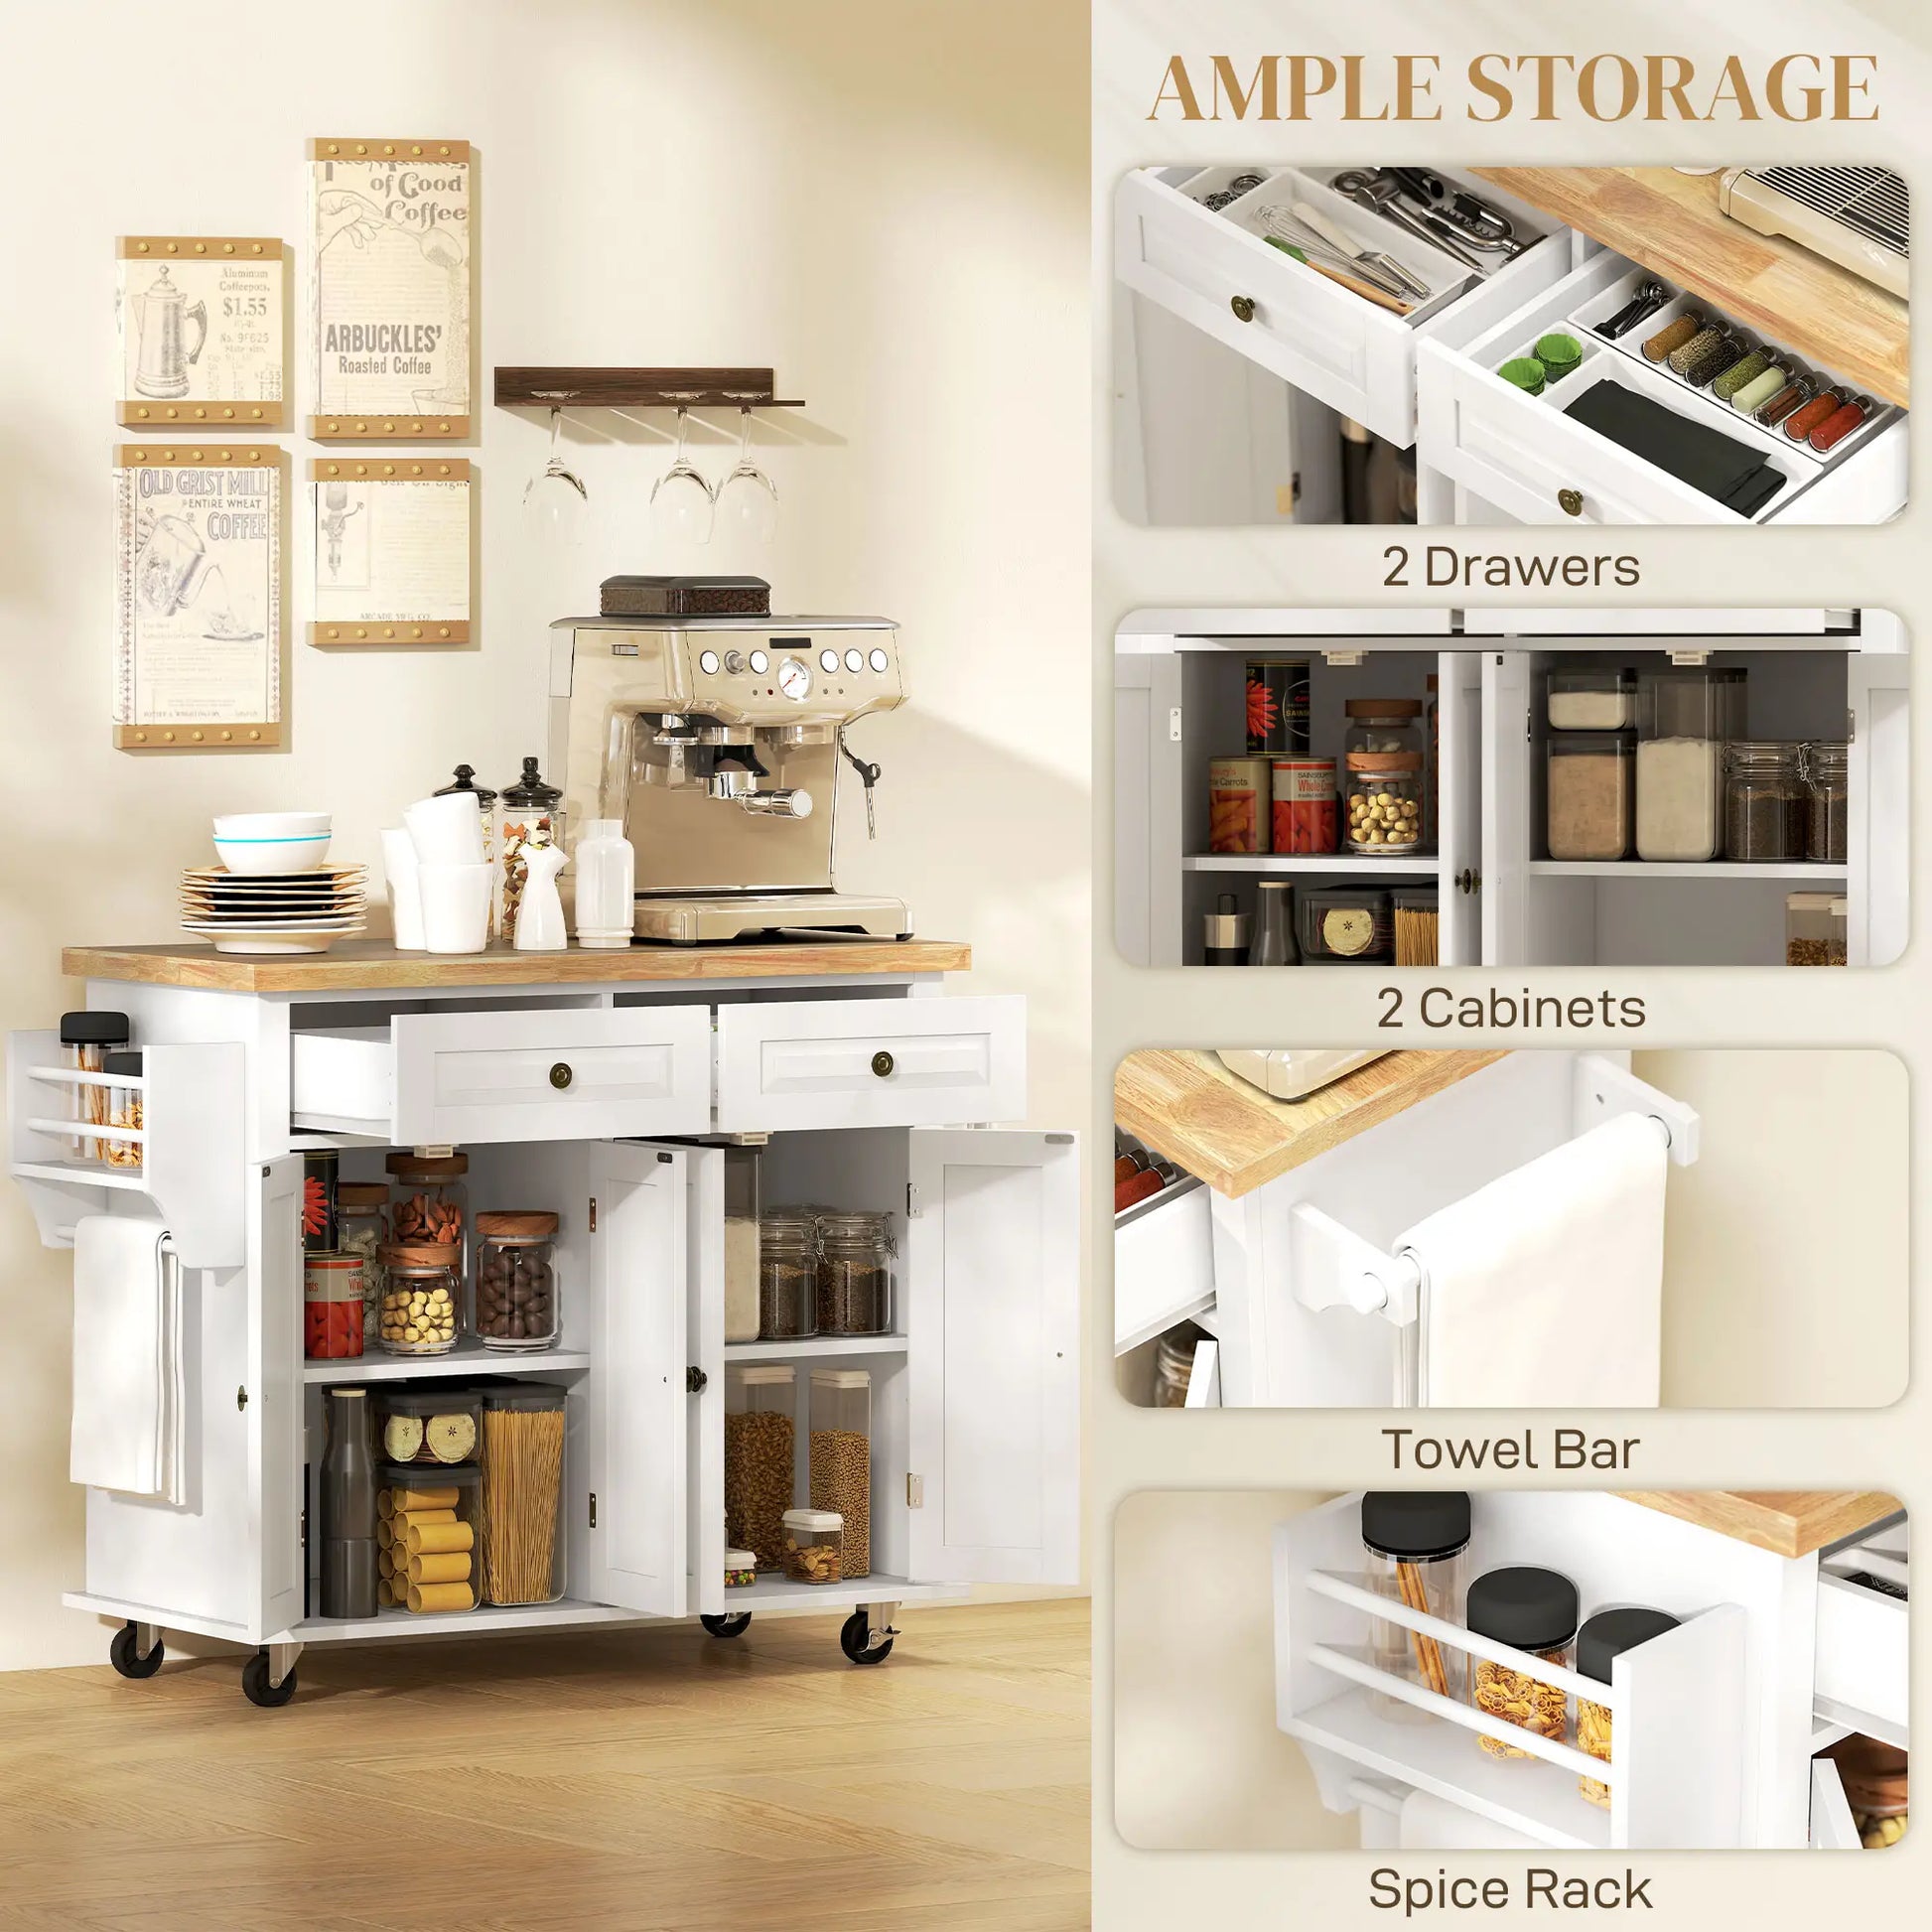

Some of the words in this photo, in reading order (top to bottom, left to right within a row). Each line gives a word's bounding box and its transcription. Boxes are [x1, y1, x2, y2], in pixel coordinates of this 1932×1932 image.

[370, 175, 394, 199] of
[398, 172, 462, 200] Good
[384, 200, 467, 228] Coffee
[222, 297, 267, 318] $1.55
[325, 324, 442, 353] ARBUCKLES'
[339, 355, 387, 374] Roasted
[393, 355, 431, 374] Coffee
[139, 469, 174, 498] OLD
[176, 470, 224, 496] GRIST
[227, 471, 268, 496] MILL
[189, 499, 223, 508] ENTIRE
[226, 499, 262, 508] WHEAT
[207, 511, 267, 541] COFFEE
[1220, 777, 1248, 786] Carrots
